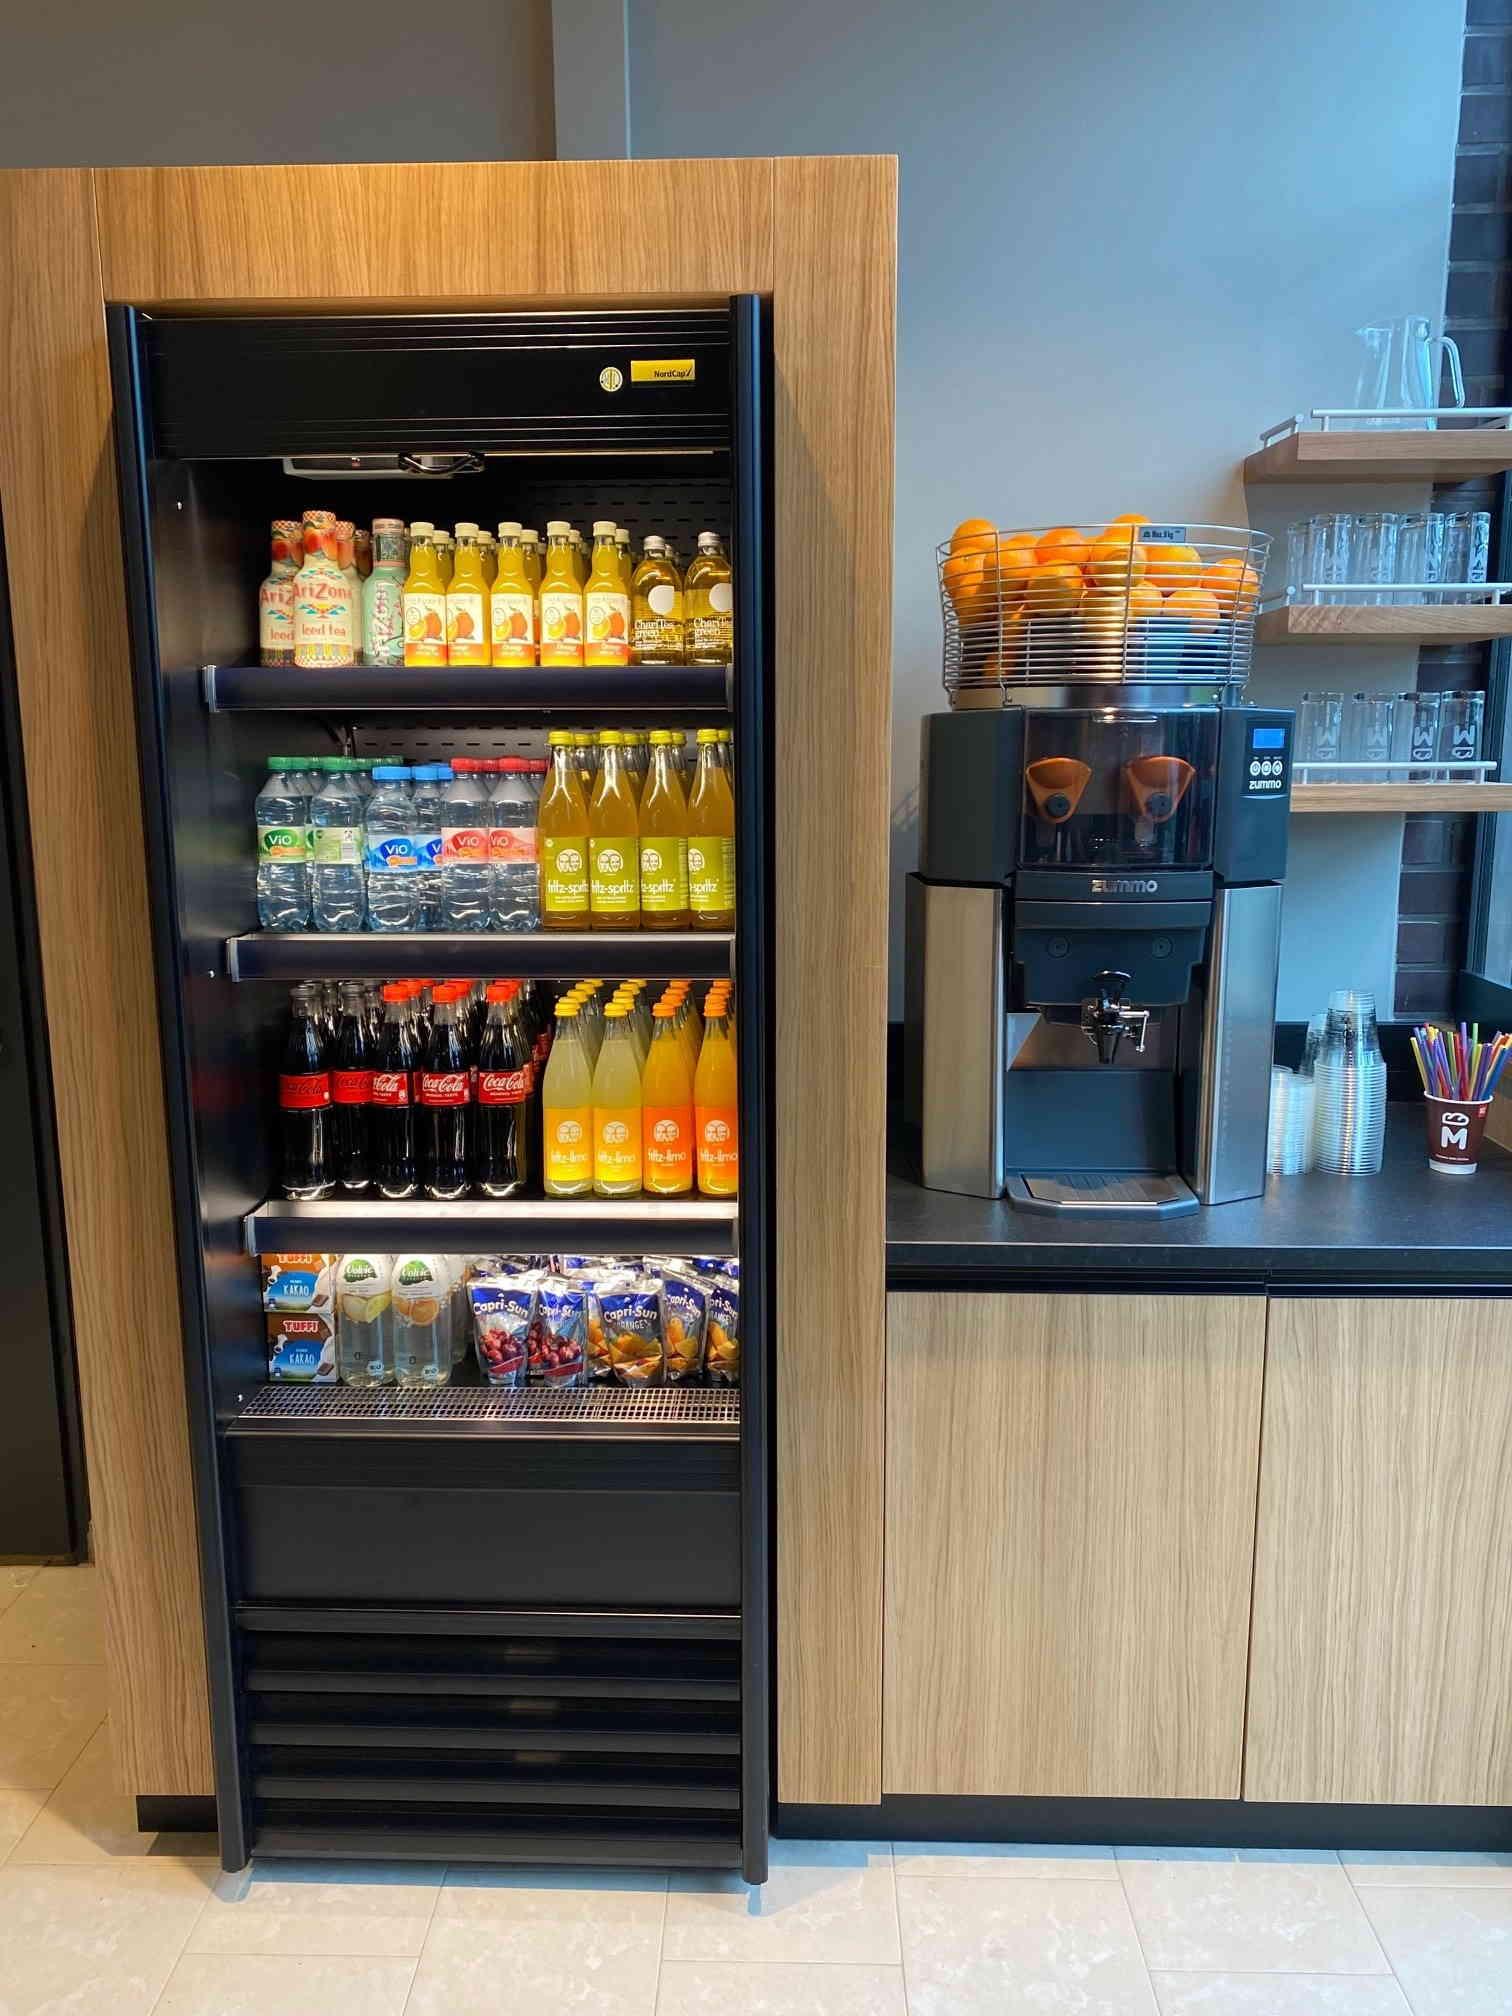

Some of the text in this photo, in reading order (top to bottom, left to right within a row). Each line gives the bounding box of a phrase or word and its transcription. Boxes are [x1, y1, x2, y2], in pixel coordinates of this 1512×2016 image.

[654, 368, 685, 378] NordCap
[1249, 780, 1282, 790] zummo
[1091, 879, 1158, 893] zummo
[283, 1285, 310, 1297] KAKAO
[473, 1298, 529, 1319] Capri-Sun
[603, 1304, 658, 1323] Capri-Sun
[283, 1320, 320, 1333] TUFFI
[289, 1353, 315, 1366] KAKAO
